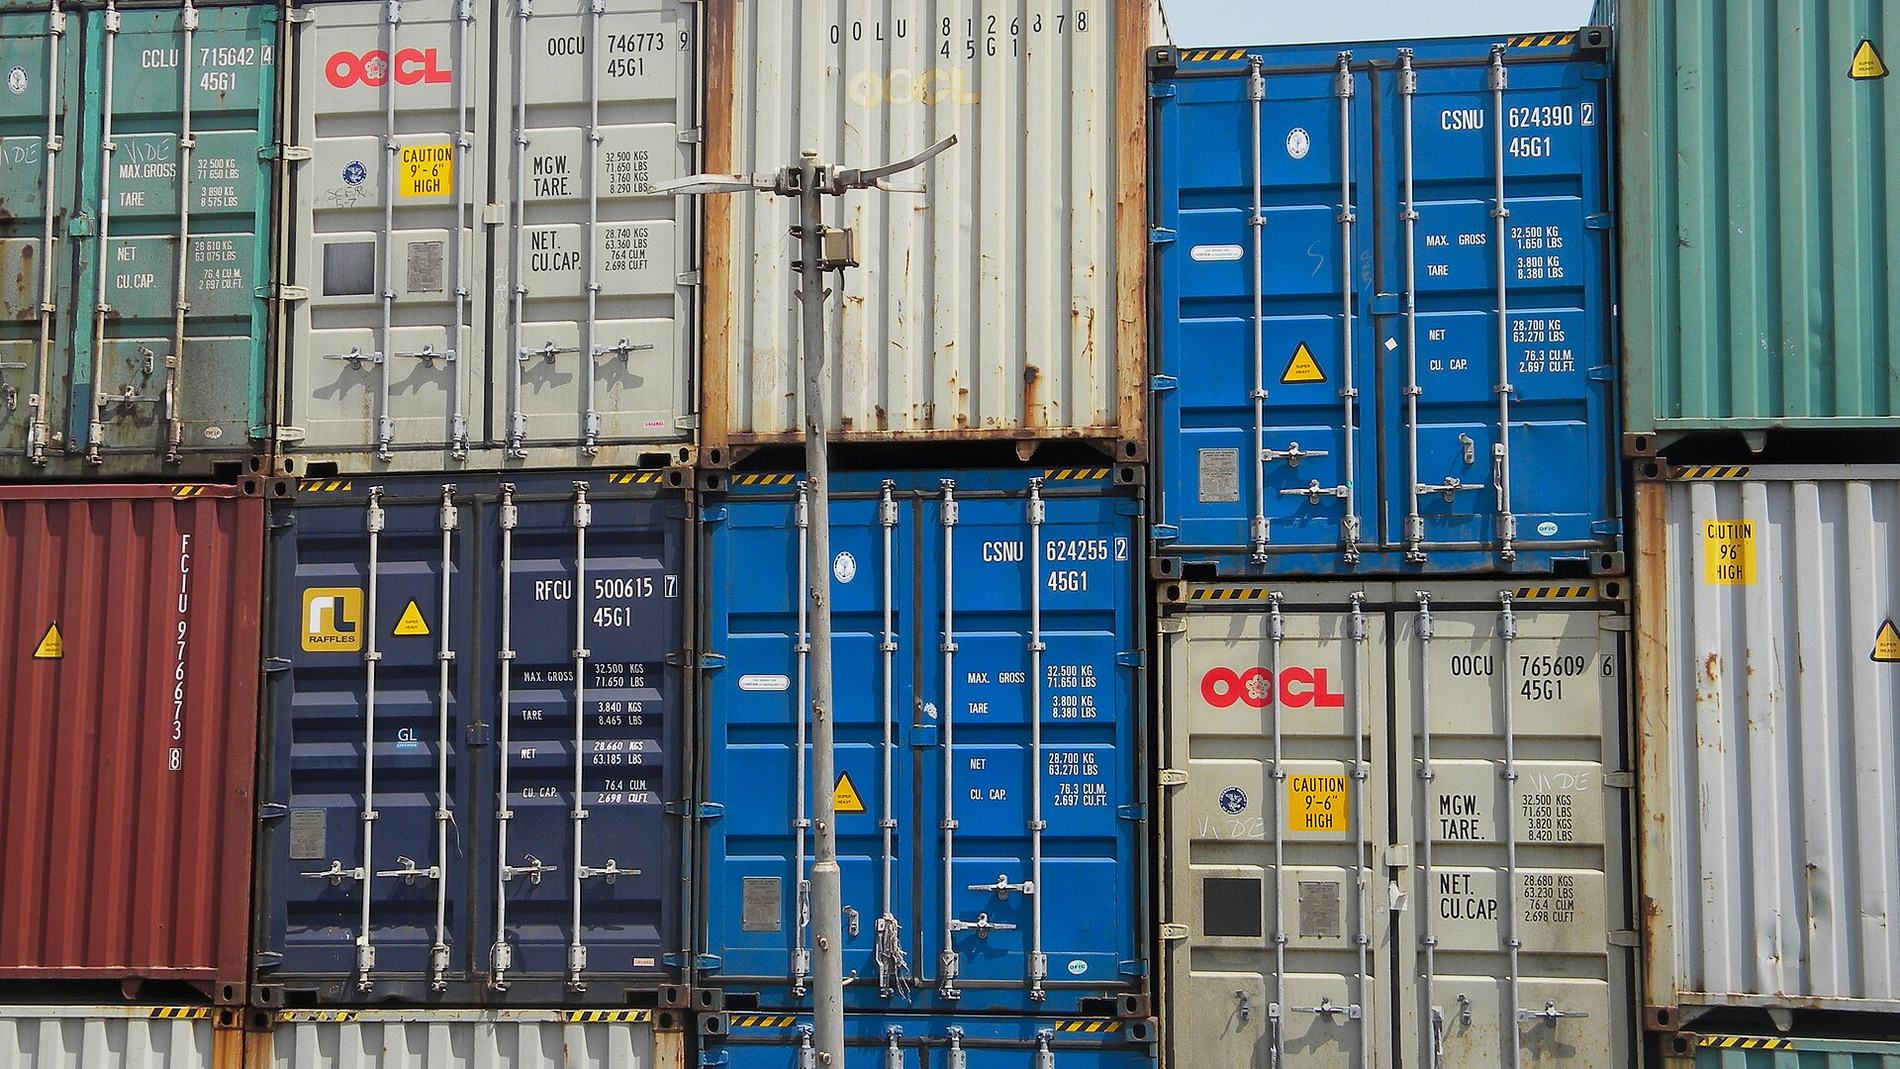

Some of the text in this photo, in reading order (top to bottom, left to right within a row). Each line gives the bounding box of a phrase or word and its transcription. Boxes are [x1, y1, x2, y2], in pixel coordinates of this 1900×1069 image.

[1077, 11, 1086, 31] 8
[547, 31, 689, 57] OOCU 746773 9
[142, 47, 272, 68] CCLU 715642 4
[324, 47, 452, 89] OOCL
[607, 57, 645, 78] 45G1
[200, 72, 236, 91] 45G1
[1441, 104, 1593, 131] CSNU 624390 2
[1509, 136, 1552, 158] 45G1
[403, 147, 452, 163] CAUTION
[605, 150, 649, 163] 32.500 KGS
[119, 162, 176, 179] MAX.GROSS
[534, 155, 571, 175] MGW.
[606, 161, 648, 172] 71.650 LBS
[610, 172, 649, 183] 3.760 KGS
[413, 178, 441, 194] HIGH
[534, 177, 572, 197] TARE.
[633, 182, 648, 192] LBS
[119, 192, 144, 207] TARE
[605, 228, 649, 239] 28.740 KGS
[1511, 226, 1559, 239] 32.500 KG
[531, 231, 561, 251] NET.
[605, 238, 647, 249] 63.360 LBS
[1426, 233, 1487, 246] MAX. GROSS
[1517, 238, 1563, 249] 1.650 LBS
[117, 246, 137, 261] NET
[532, 252, 581, 272] CU.CAP.
[605, 260, 626, 271] 2.698
[1517, 256, 1560, 268] 3.800 KG
[1427, 264, 1449, 276] TARE
[1517, 267, 1564, 279] 8.380 LBS
[116, 274, 157, 288] CU.CAP.
[1513, 320, 1561, 332] 28.700 KG
[1429, 329, 1446, 341] NET
[1513, 331, 1565, 342] 63.270 LBS
[1524, 350, 1574, 361] 76.3 CU.M.
[1430, 358, 1468, 371] CU. CAP.
[1519, 361, 1575, 373] 2.697 CU.FT.
[1708, 524, 1751, 539] CUTION
[983, 539, 1126, 562] CSNU 624255 2
[1047, 570, 1087, 592] 45G1
[536, 577, 675, 601] RFCU 500615 7
[593, 607, 632, 627] 45G1
[170, 534, 190, 769] FCIU 976673 8
[594, 663, 644, 674] 32.500 KGS
[1047, 665, 1093, 677] 32.500 KG
[1451, 655, 1612, 676] OOCU 765609 6
[524, 671, 574, 682] MAX. GROSS
[595, 677, 644, 687] 71.650 LBS
[967, 672, 1025, 684] MAX. GROSS
[1047, 677, 1096, 688] 71.650 LBS
[1200, 666, 1345, 709] OOCL
[1520, 680, 1563, 700] 45G1
[598, 702, 642, 712] 3.840 KGS
[1052, 696, 1093, 707] 3.800 KG
[968, 703, 988, 714] TARE
[1052, 707, 1096, 718] 8.380 LBS
[522, 710, 543, 720] TARE
[598, 715, 643, 726] 8.465 LBS
[397, 728, 417, 741] GL
[593, 741, 643, 751] 28.660 KGS
[521, 749, 536, 759] NET
[593, 754, 642, 765] 63.185 LBS
[1049, 753, 1094, 764] 28.700 KG
[970, 759, 986, 770] NET
[1049, 764, 1098, 775] 63.270 LBS
[1059, 783, 1107, 794] 76.3 CU.M.
[1293, 777, 1344, 792] CAUTION
[522, 787, 557, 798] CU. CAP.
[970, 789, 1006, 800] CU. CAP.
[1054, 795, 1108, 806] 2.697 CU.FT.
[1439, 795, 1481, 816] MGW.
[1522, 794, 1572, 806] 32.500 KGS
[1523, 806, 1572, 818] 71.650 LBS
[1305, 813, 1333, 828] HIGH
[1528, 818, 1572, 830] 3.820 KGS
[1440, 819, 1485, 840] TARE.
[1528, 830, 1573, 841] 8.420 LBS
[1439, 874, 1474, 895] NET.
[1524, 875, 1573, 887] 28.680 KGS
[1524, 887, 1574, 899] 63.230 LBS
[1440, 899, 1498, 920] CU.CAP.
[1530, 899, 1549, 910] 76.4
[1524, 911, 1549, 922] 2.698
